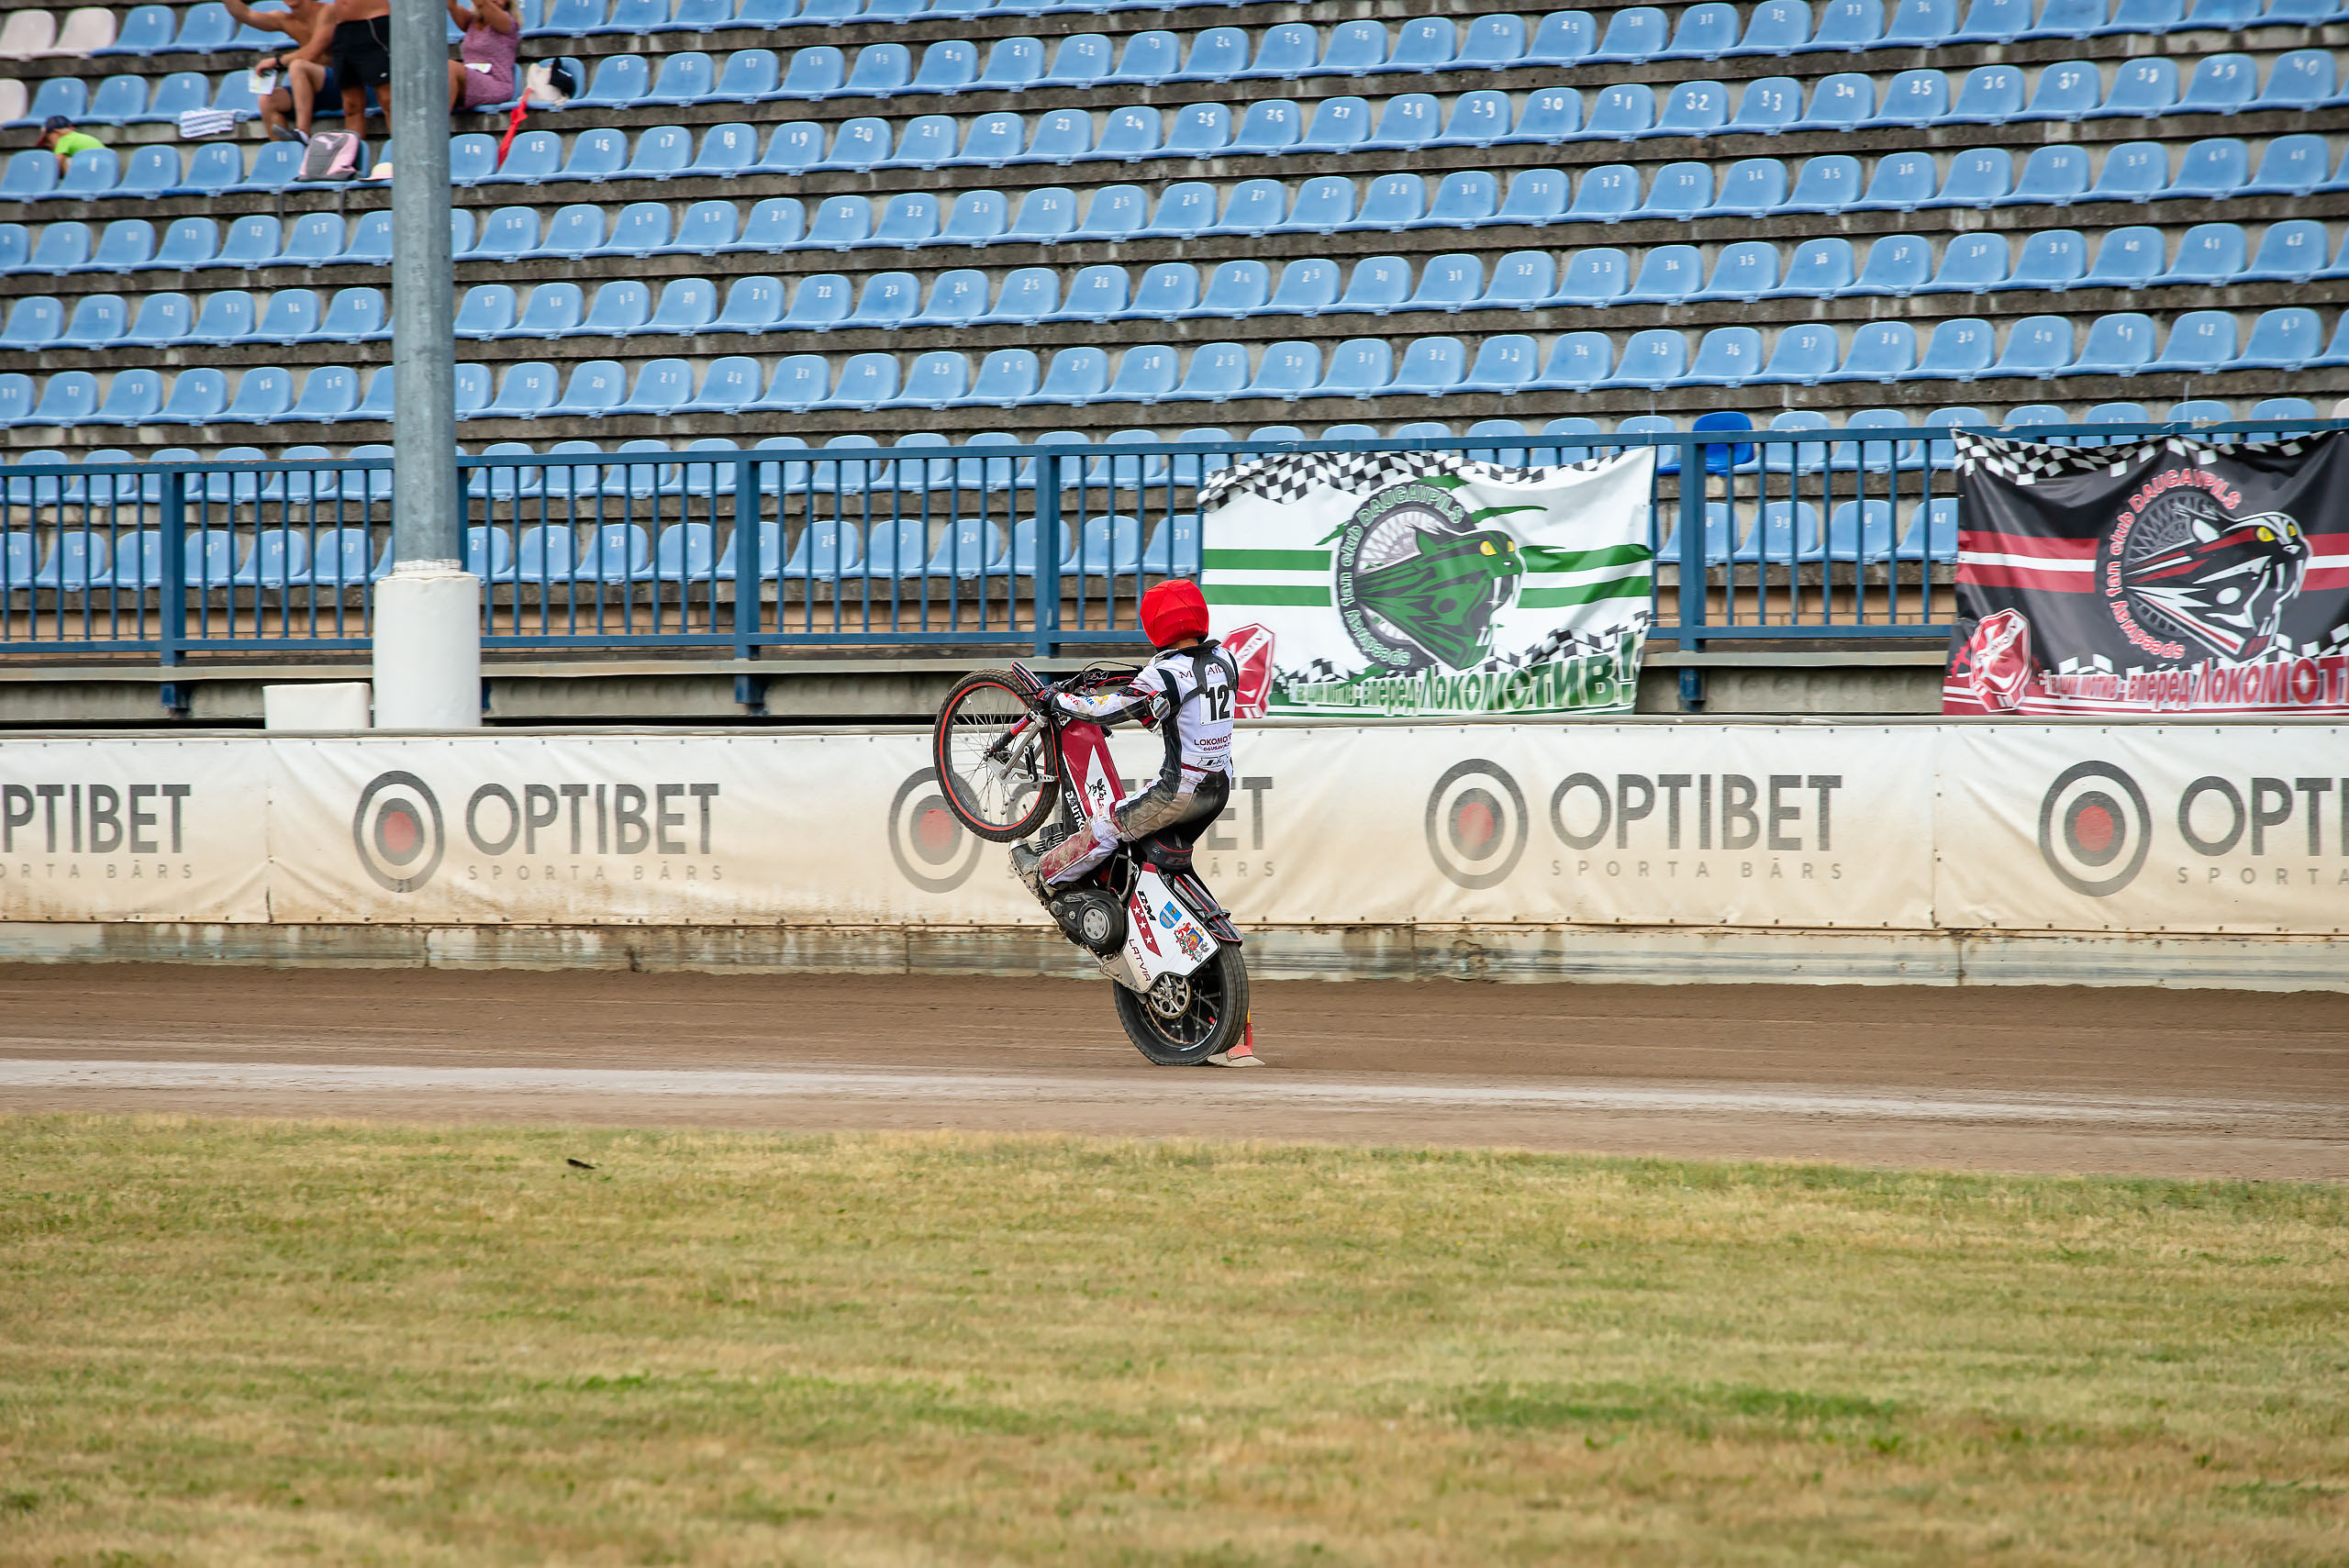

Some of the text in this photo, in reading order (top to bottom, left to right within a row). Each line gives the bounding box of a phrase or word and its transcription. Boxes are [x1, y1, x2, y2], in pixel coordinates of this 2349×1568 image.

[1910, 79, 1932, 96] 35
[1983, 75, 2005, 90] 36
[2058, 72, 2080, 90] 37
[1835, 83, 1855, 98] 34
[1542, 96, 1564, 111] 30
[1686, 92, 1710, 111] 32
[1761, 90, 1783, 112] 33
[1266, 108, 1285, 122] 26
[1332, 106, 1352, 119] 27
[1472, 99, 1496, 118] 29
[1055, 117, 1071, 131] 23
[1125, 115, 1144, 130] 24
[1197, 111, 1216, 128] 25
[922, 124, 941, 138] 21
[990, 121, 1007, 135] 22
[530, 139, 546, 152] 15
[595, 139, 610, 152] 16
[791, 131, 808, 148] 19
[1601, 173, 1621, 188] 32
[1822, 167, 1842, 180] 35
[1251, 189, 1266, 202] 27
[907, 205, 923, 217] 22
[2286, 232, 2304, 247] 42
[2049, 241, 2069, 254] 39
[1739, 253, 1755, 266] 35
[1518, 263, 1534, 276] 32
[1592, 261, 1612, 273] 33
[1093, 275, 1109, 288] 26
[1163, 274, 1179, 287] 27
[1448, 269, 1463, 282] 31
[817, 285, 832, 298] 22
[884, 284, 900, 298] 23
[1957, 329, 1976, 344] 39
[2198, 323, 2216, 337] 42
[1652, 341, 1668, 356] 35
[1725, 342, 1741, 356] 36
[1801, 336, 1818, 349] 37
[1358, 350, 1376, 364] 31
[932, 361, 951, 375] 25
[1205, 684, 1230, 722] 12
[1550, 772, 1842, 851] OPTIBET
[466, 783, 719, 856] OPTIBET
[106, 859, 192, 879] BĀRS
[467, 861, 723, 881] SPORTA BĀRS
[1208, 857, 1275, 877] ĀRS
[1551, 857, 1842, 880] SPORTA BĀRS
[1128, 939, 1152, 982] LATVIA
